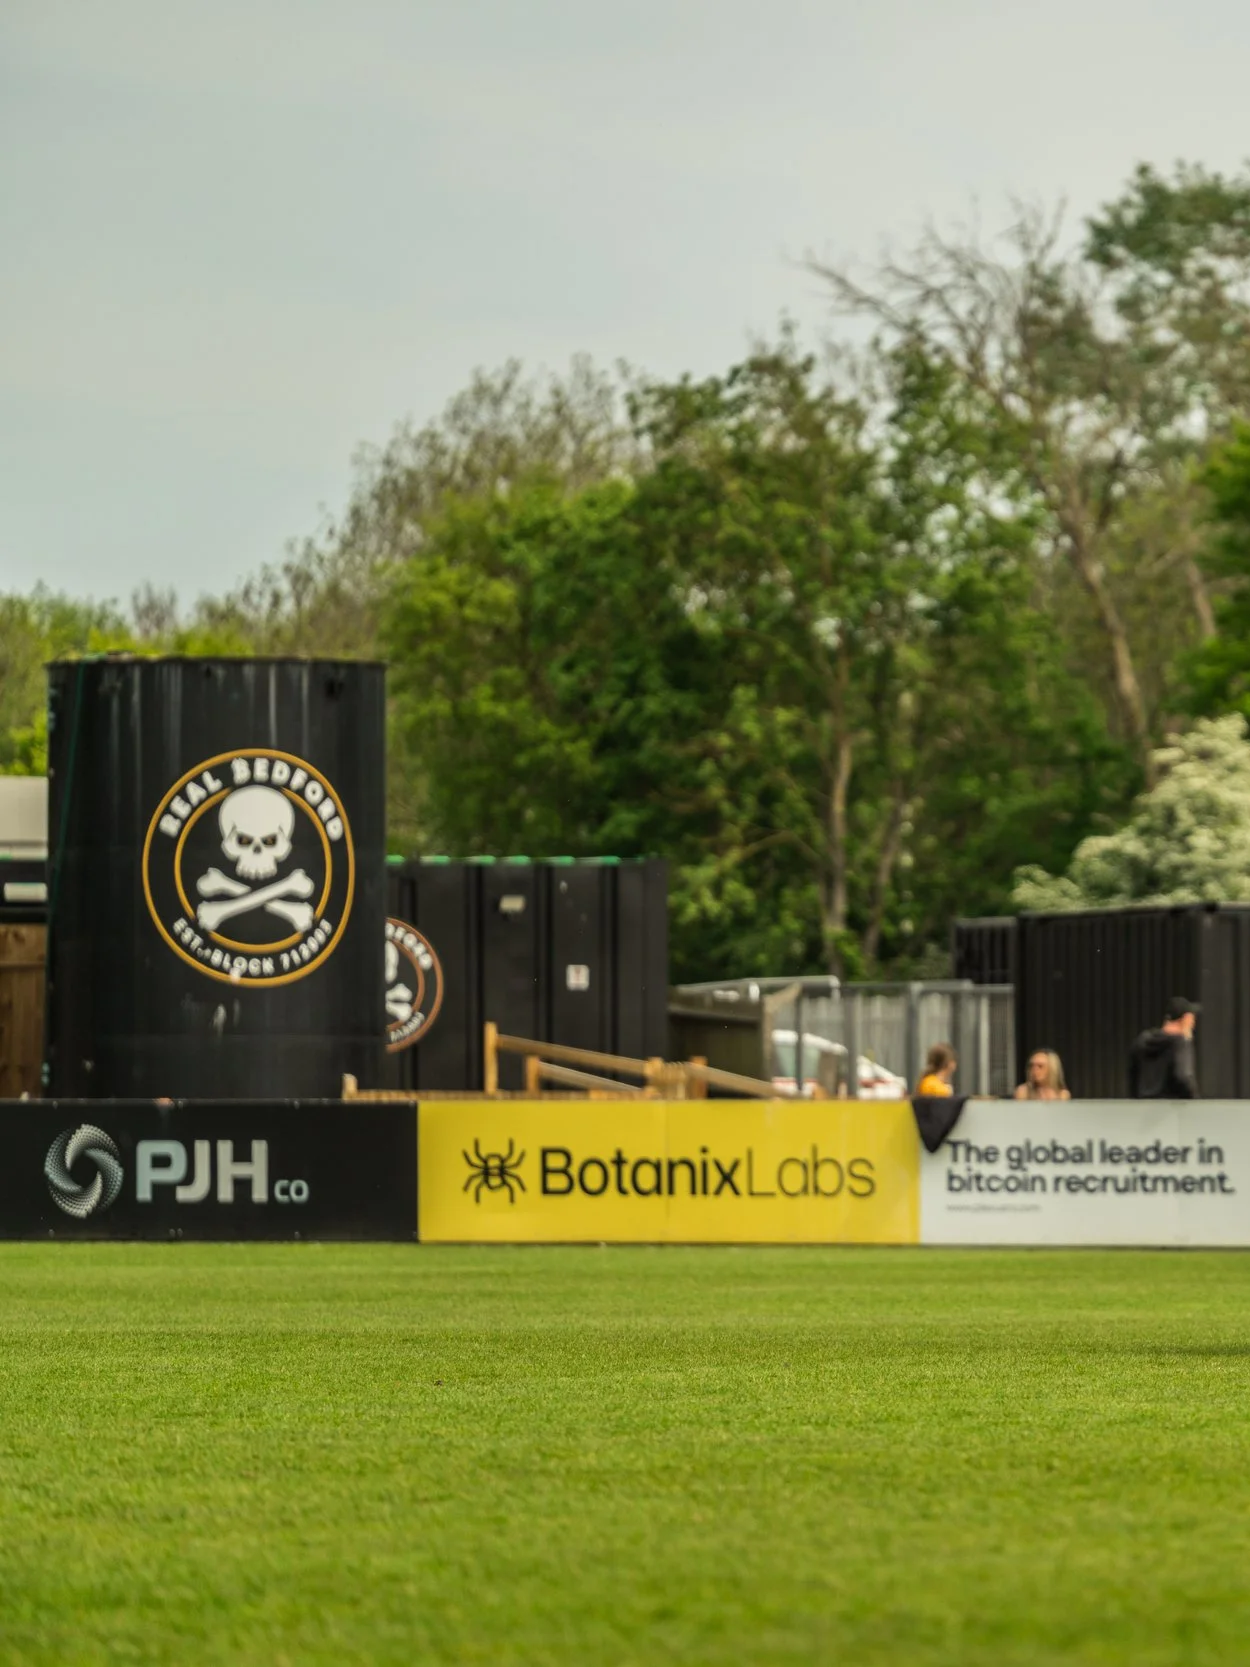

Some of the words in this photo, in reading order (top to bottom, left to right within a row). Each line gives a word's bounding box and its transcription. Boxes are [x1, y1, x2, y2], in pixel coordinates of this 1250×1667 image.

[159, 770, 223, 838] REAL
[135, 1139, 269, 1203] PJH
[540, 1144, 876, 1199] BotanixLabs
[946, 1168, 1047, 1194] bitcoin
[1053, 1168, 1237, 1194] recruitment.
[948, 1139, 1000, 1164] The
[1005, 1139, 1093, 1170] global
[1099, 1139, 1192, 1164] leader
[1198, 1138, 1224, 1164] in
